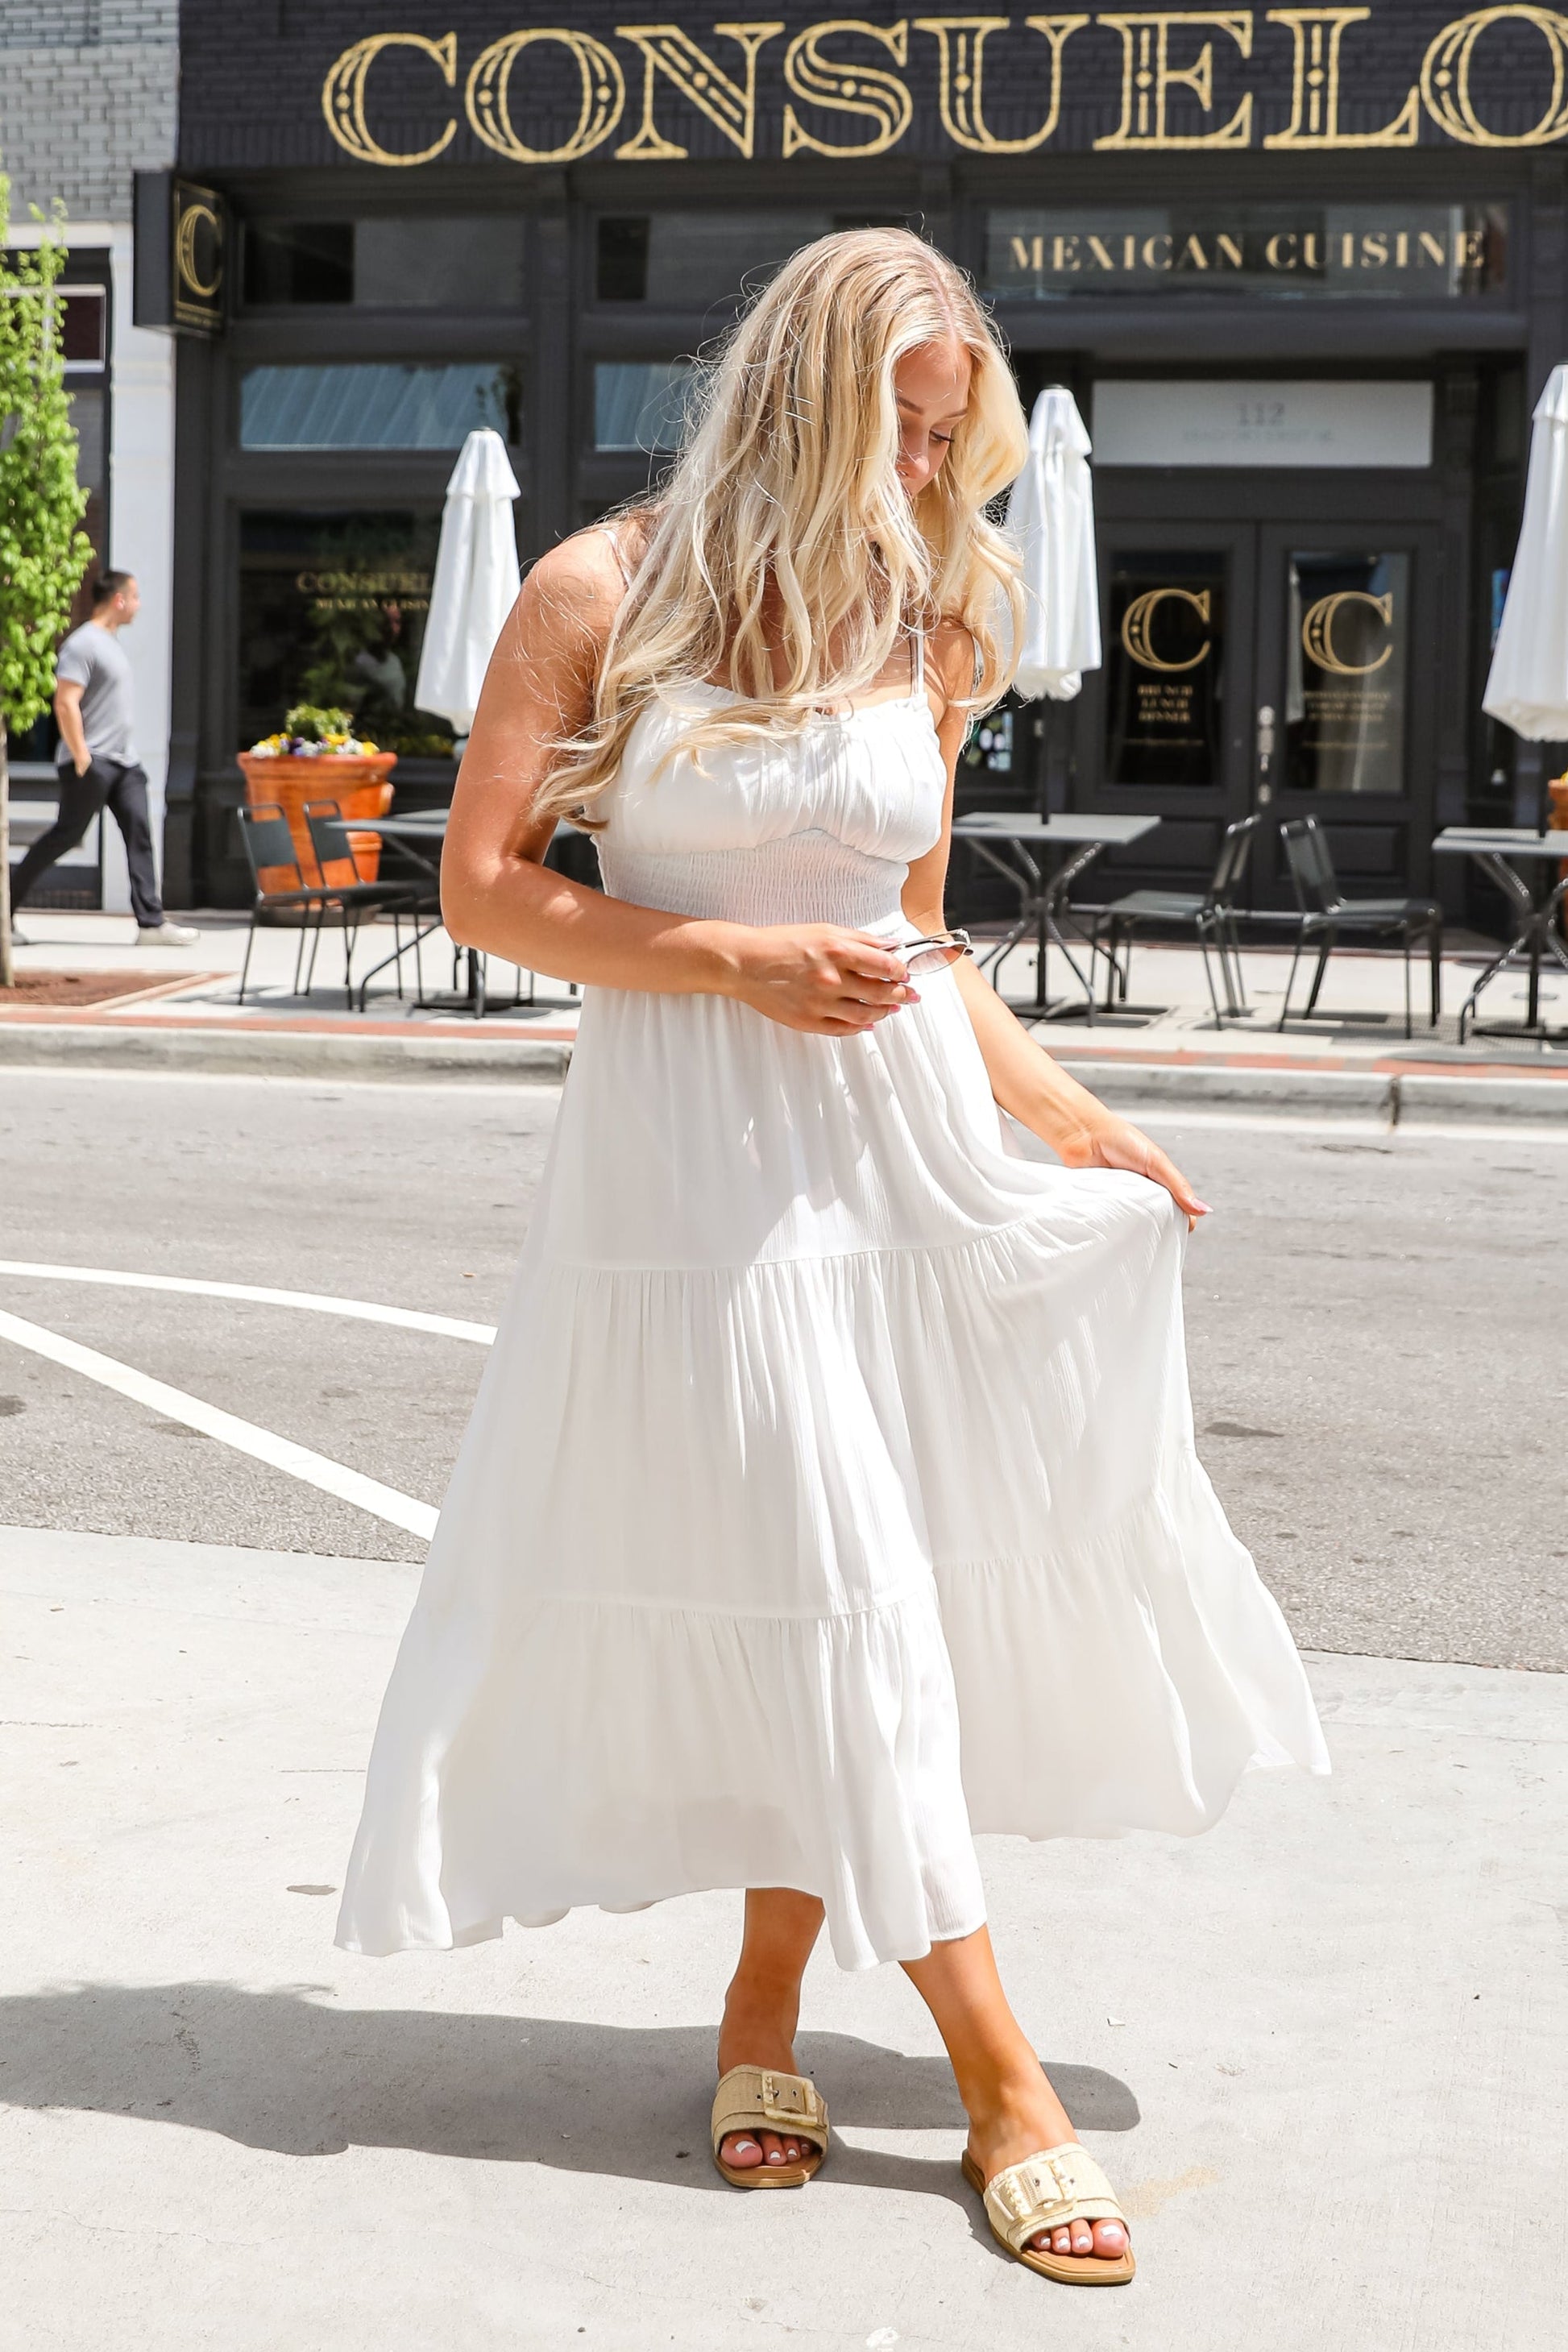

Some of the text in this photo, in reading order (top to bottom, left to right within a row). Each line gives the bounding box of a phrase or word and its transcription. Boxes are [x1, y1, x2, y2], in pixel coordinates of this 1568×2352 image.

[323, 4, 1568, 166] CONSUELO
[176, 204, 223, 297] C
[1009, 230, 1485, 272] MEXICAN CUISINE
[296, 571, 430, 593] CONSUEL
[1121, 588, 1210, 672] C
[1303, 591, 1392, 675] C
